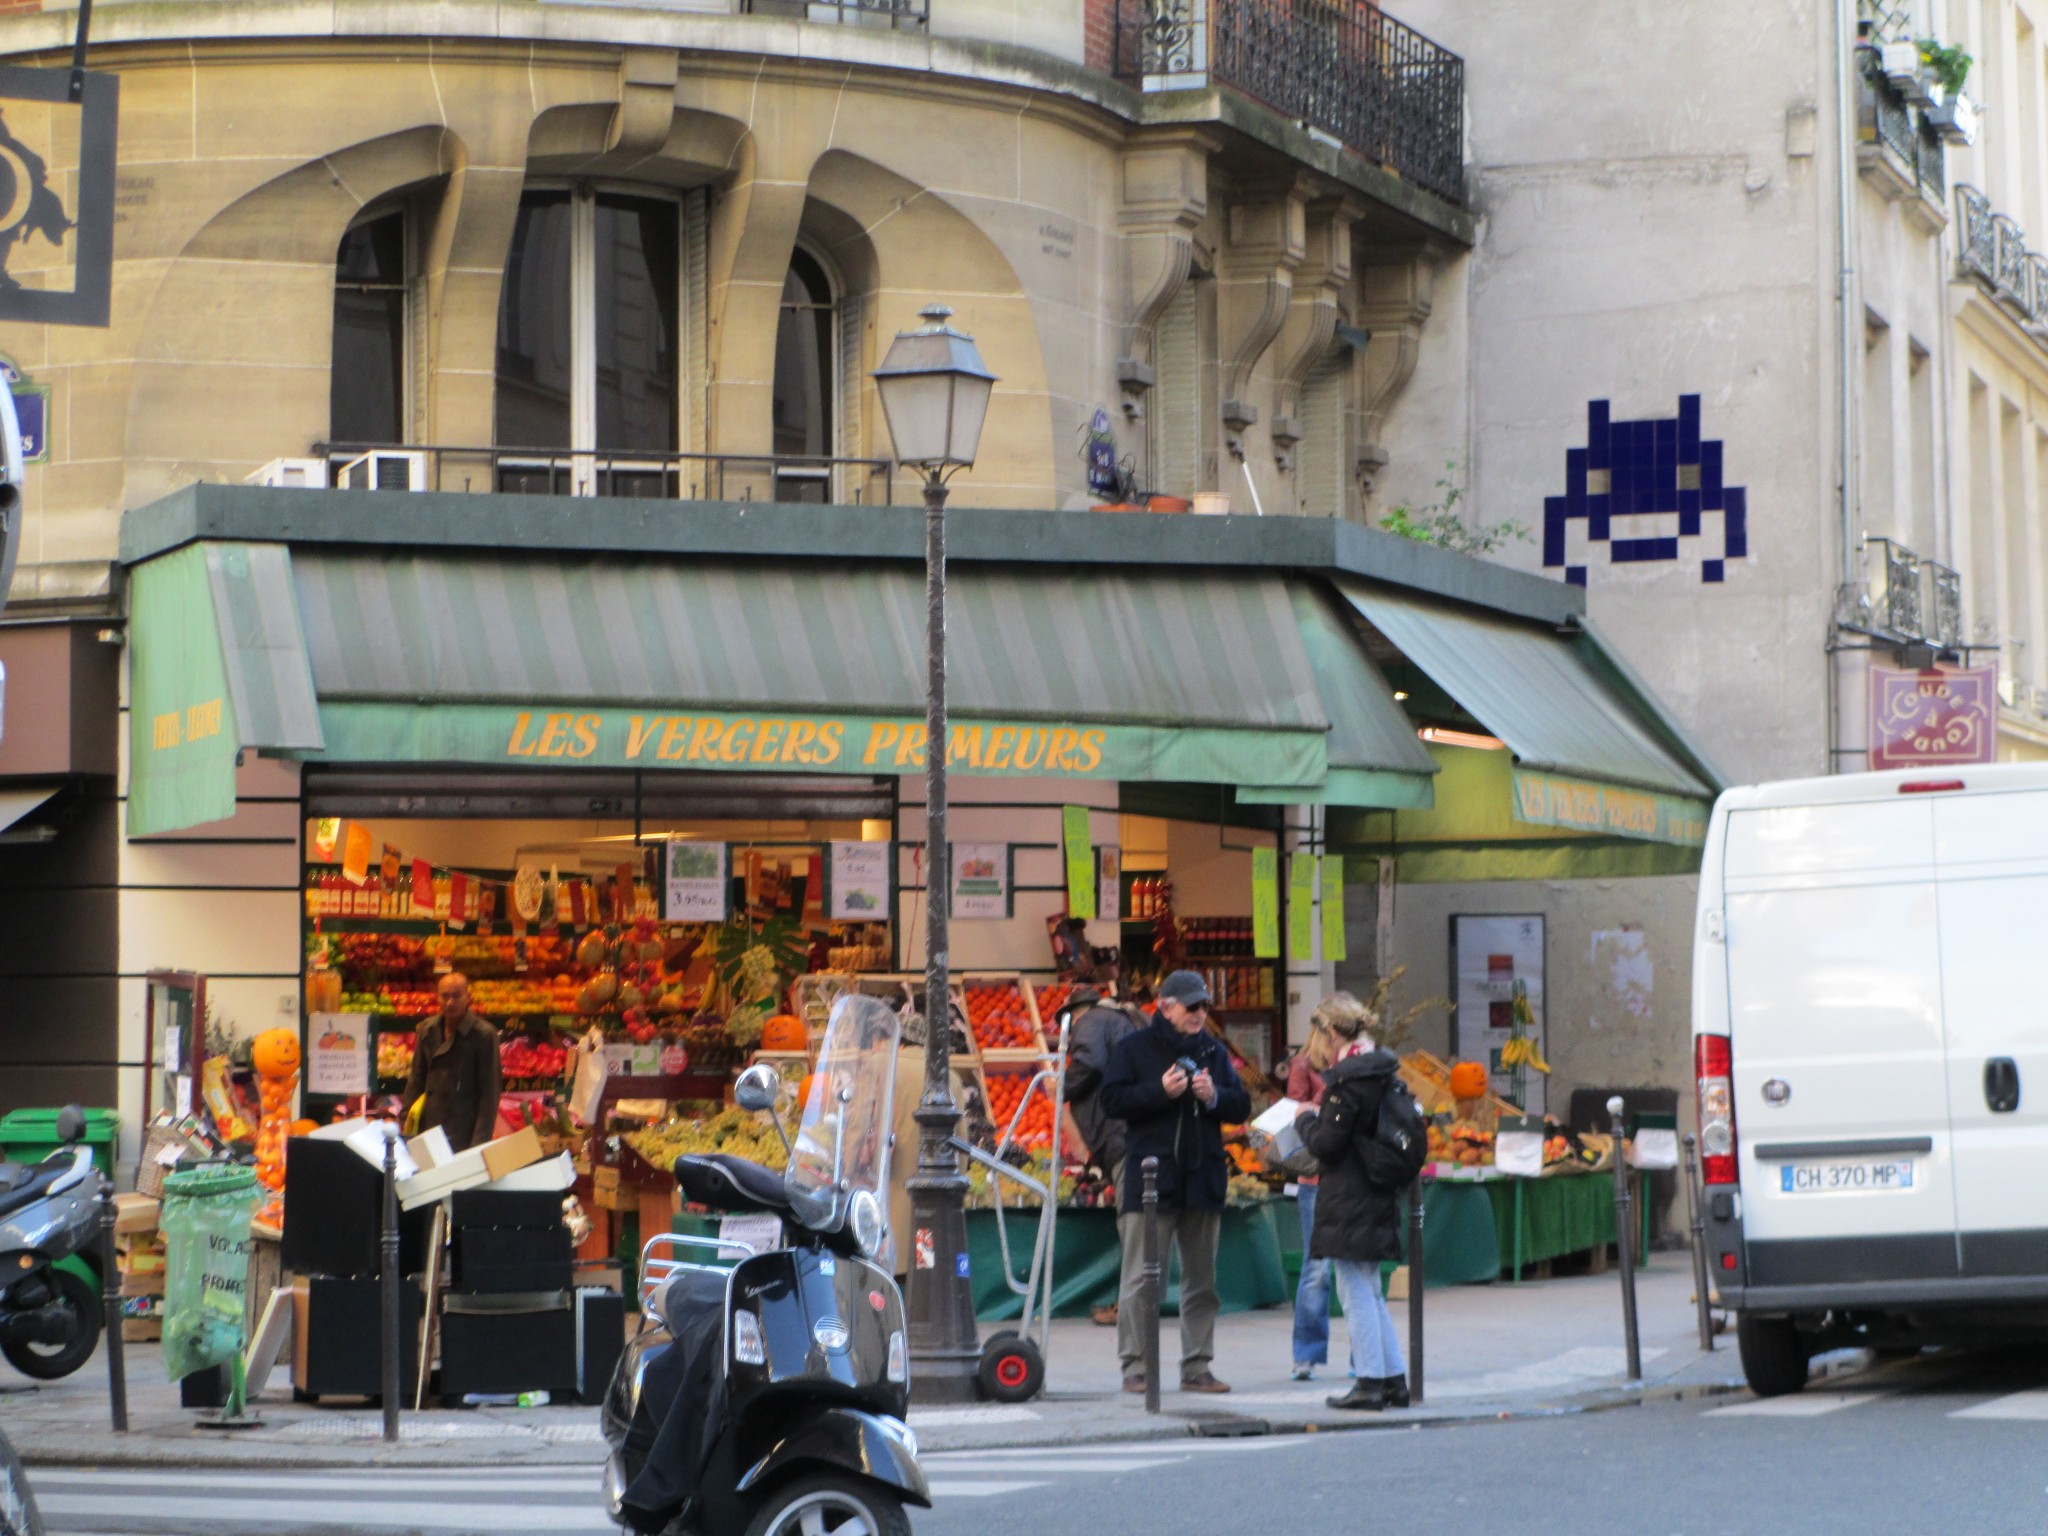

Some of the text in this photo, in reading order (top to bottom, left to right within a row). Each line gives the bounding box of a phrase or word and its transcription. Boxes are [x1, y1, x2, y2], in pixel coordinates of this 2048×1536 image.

[507, 711, 1106, 772] LES VERGERS PRMEURS
[1795, 1165, 1898, 1188] CH 370 MP
